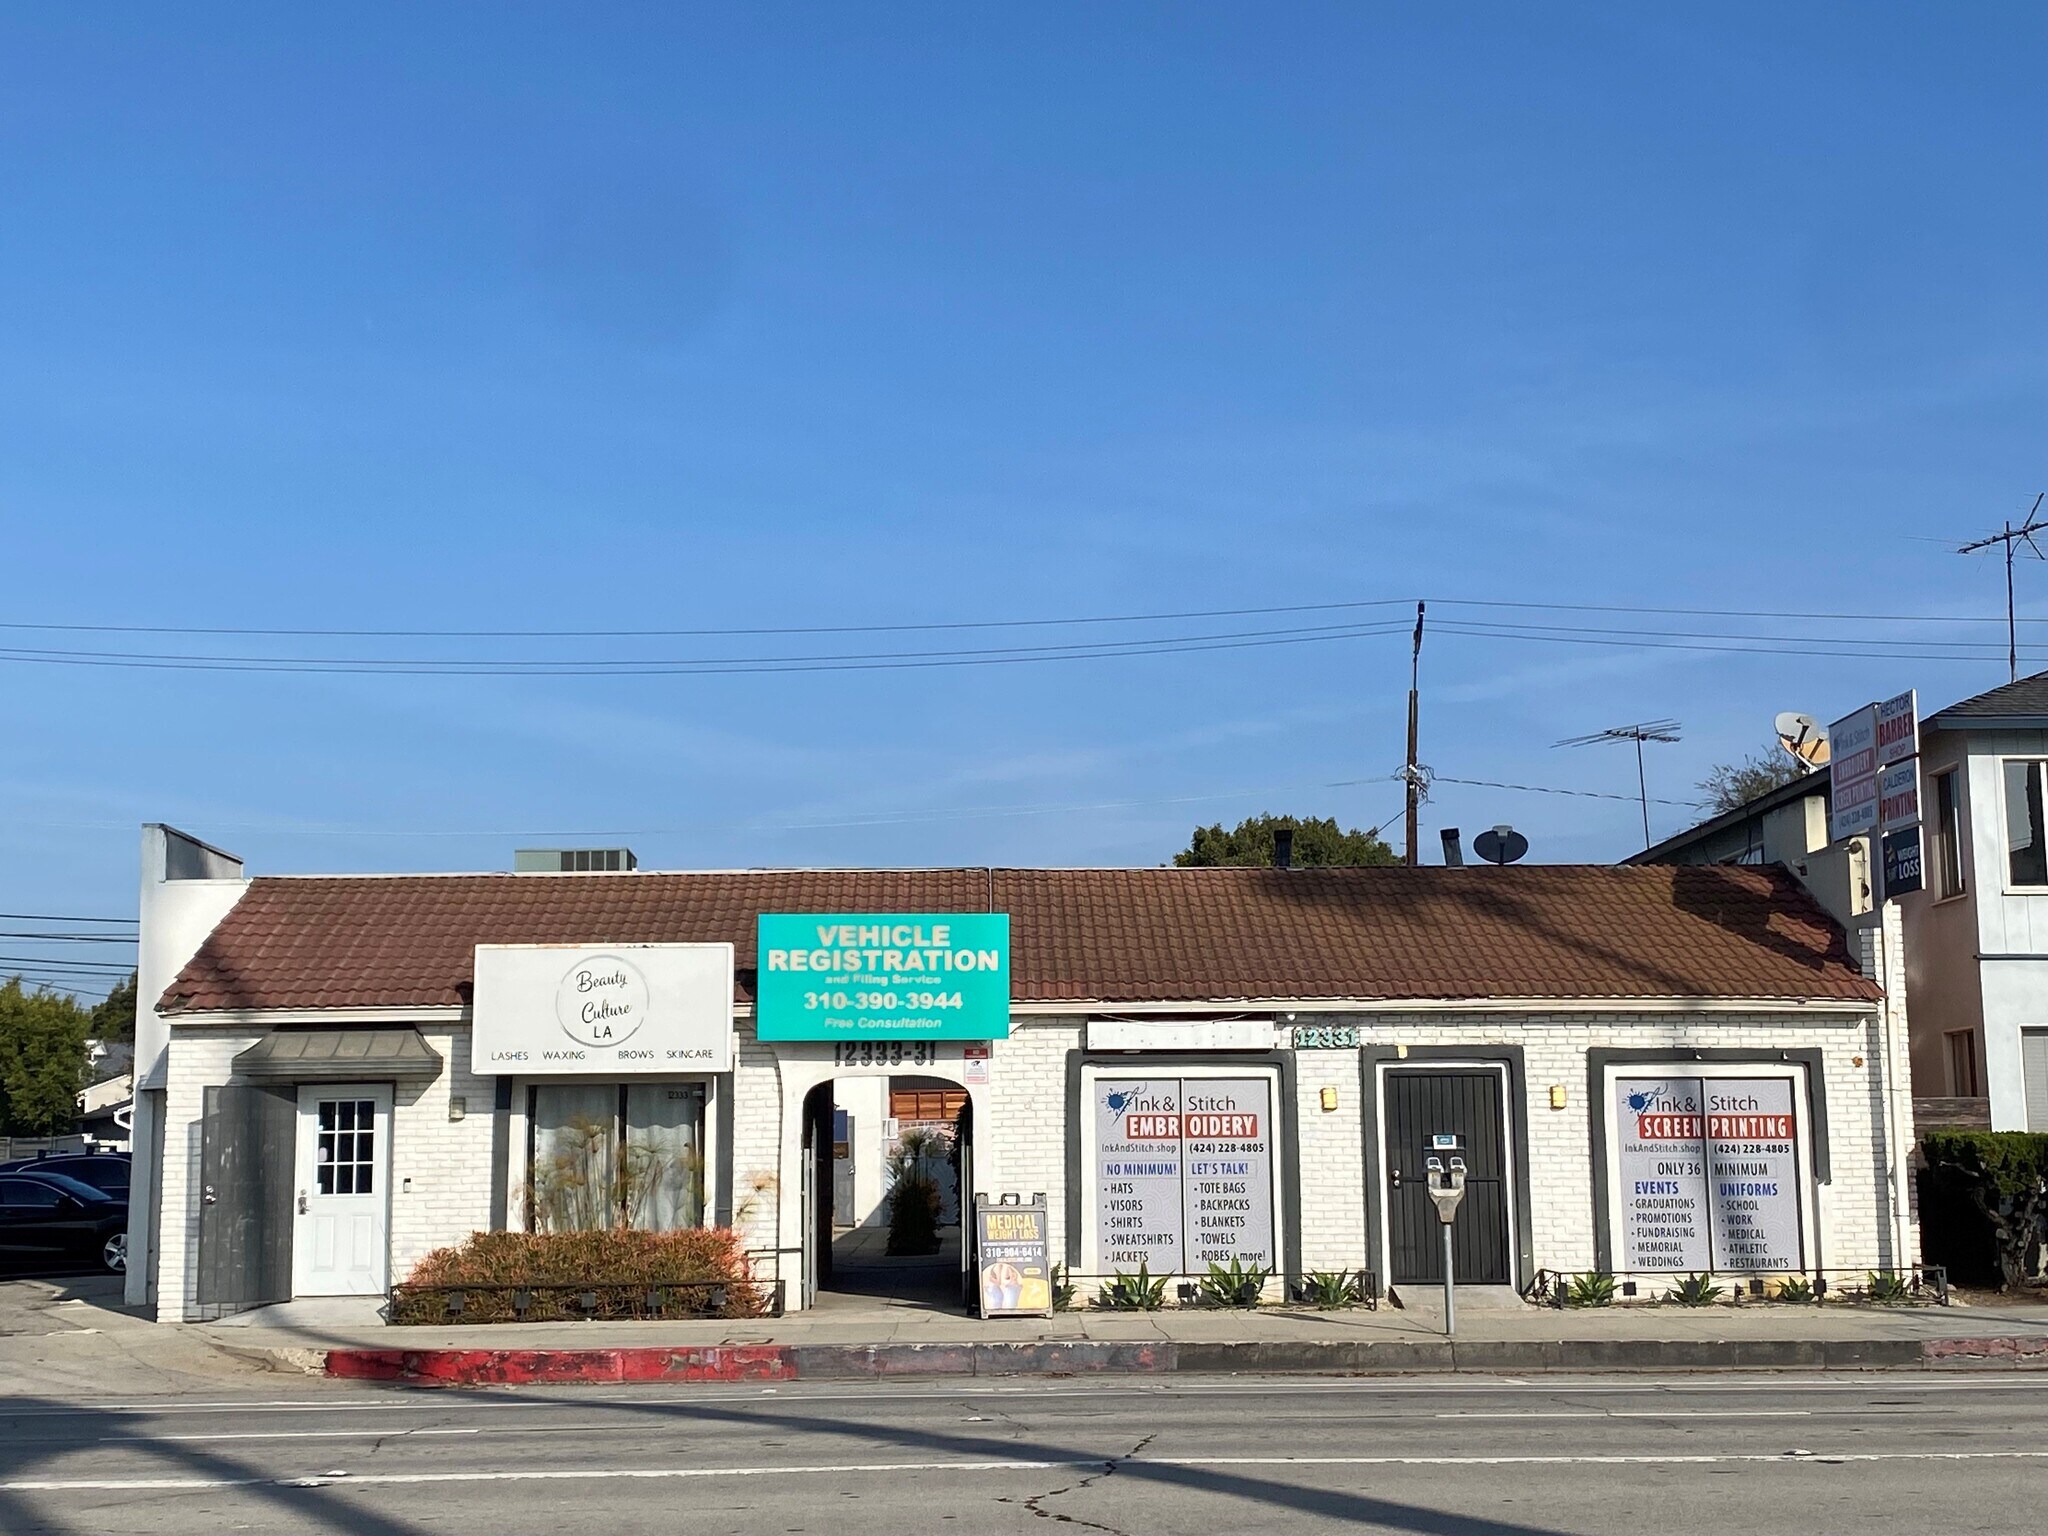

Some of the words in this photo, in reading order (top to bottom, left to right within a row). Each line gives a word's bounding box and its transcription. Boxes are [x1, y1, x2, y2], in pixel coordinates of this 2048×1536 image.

[1880, 694, 1911, 717] HECTOR
[1879, 712, 1914, 747] BARBER
[1889, 743, 1906, 759] SHOP
[1883, 769, 1915, 792] CALDERON
[1881, 789, 1917, 823] PRINTING
[1898, 858, 1920, 880] LOSS
[816, 925, 950, 947] VEHICLE
[768, 949, 998, 971] REGISTRATION
[576, 970, 628, 993] Beauty
[825, 974, 849, 984] and
[853, 974, 888, 986] Filing
[892, 974, 942, 984] Service
[803, 991, 963, 1010] 310-390-3944
[581, 999, 633, 1024] Culture
[824, 1018, 854, 1029] Free
[858, 1017, 942, 1029] Consultation
[491, 1052, 529, 1061] LASHES
[542, 1051, 586, 1061] WAXING
[618, 1050, 655, 1059] BROWS
[666, 1049, 714, 1059] SKINCARE
[834, 1041, 936, 1066] 12333-31
[1188, 1096, 1236, 1112] Stitch
[1710, 1095, 1759, 1111] Stitch
[1644, 1117, 1701, 1137] SCREEN
[1711, 1117, 1787, 1137] PRINTING
[1101, 1143, 1177, 1154] InkAndStitch.shop
[1189, 1143, 1216, 1154] (424)
[1218, 1143, 1264, 1153] 228-4805
[1624, 1143, 1701, 1154] InkAndStitch.shop
[1713, 1144, 1741, 1155] (424)
[1743, 1144, 1790, 1154] 228-4805
[1106, 1164, 1121, 1175] NO
[1123, 1163, 1177, 1175] MINIMUM!
[1191, 1163, 1218, 1175] LET'S
[1220, 1163, 1248, 1175] TALK!
[1657, 1162, 1685, 1175] ONLY
[1687, 1162, 1701, 1175] 36
[1714, 1163, 1768, 1176] MINIMUM
[1110, 1183, 1133, 1194] HATS
[1199, 1183, 1221, 1194] TOTE
[1222, 1183, 1246, 1194] BAGS
[1634, 1181, 1679, 1195] EVENTS
[1719, 1183, 1778, 1196] UNIFORMS
[1110, 1200, 1143, 1211] VISORS
[1200, 1199, 1250, 1210] BACKPACKS
[1635, 1198, 1695, 1209] GRADUATIONS
[1726, 1200, 1760, 1211] SCHOOL
[986, 1214, 1039, 1230] MEDICAL
[1110, 1217, 1143, 1228] SHIRTS
[1200, 1216, 1245, 1228] BLANKETS
[1636, 1213, 1693, 1224] PROMOTIONS
[1726, 1215, 1753, 1225] WORK
[987, 1229, 1018, 1240] WEIGHT
[1019, 1229, 1040, 1240] LOSS
[1200, 1233, 1236, 1244] TOWELS
[1637, 1227, 1695, 1238] FUNDRAISING
[1728, 1229, 1766, 1240] MEDICAL
[1111, 1233, 1174, 1246] SWEATSHIRTS
[985, 1246, 1042, 1258] 310-904-6414
[1638, 1242, 1684, 1252] MEMORIAL
[1729, 1243, 1768, 1254] ATHLETIC
[1111, 1251, 1149, 1262] JACKETS
[1201, 1250, 1230, 1261] ROBES
[1638, 1256, 1684, 1267] WEDDINGS
[1729, 1257, 1789, 1269] RESTAURANTS
